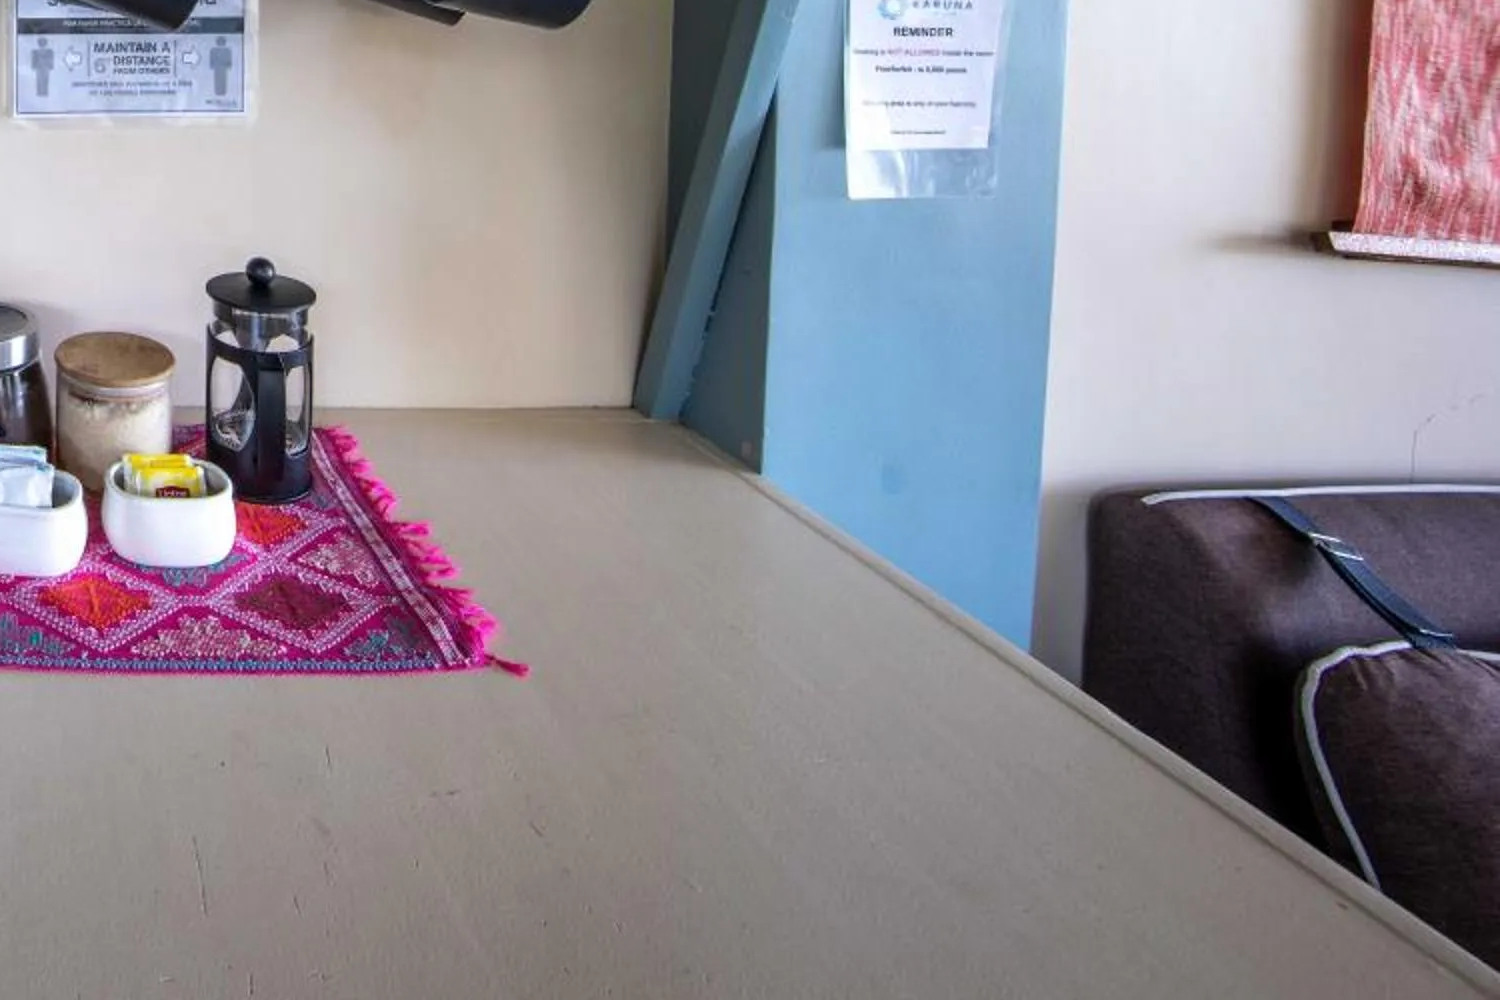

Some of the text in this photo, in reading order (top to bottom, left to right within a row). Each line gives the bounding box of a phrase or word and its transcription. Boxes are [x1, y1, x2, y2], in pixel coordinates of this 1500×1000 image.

[893, 27, 954, 36] REMINDER
[93, 41, 172, 53] MAINTAIN A
[113, 56, 171, 66] DISTANCE
